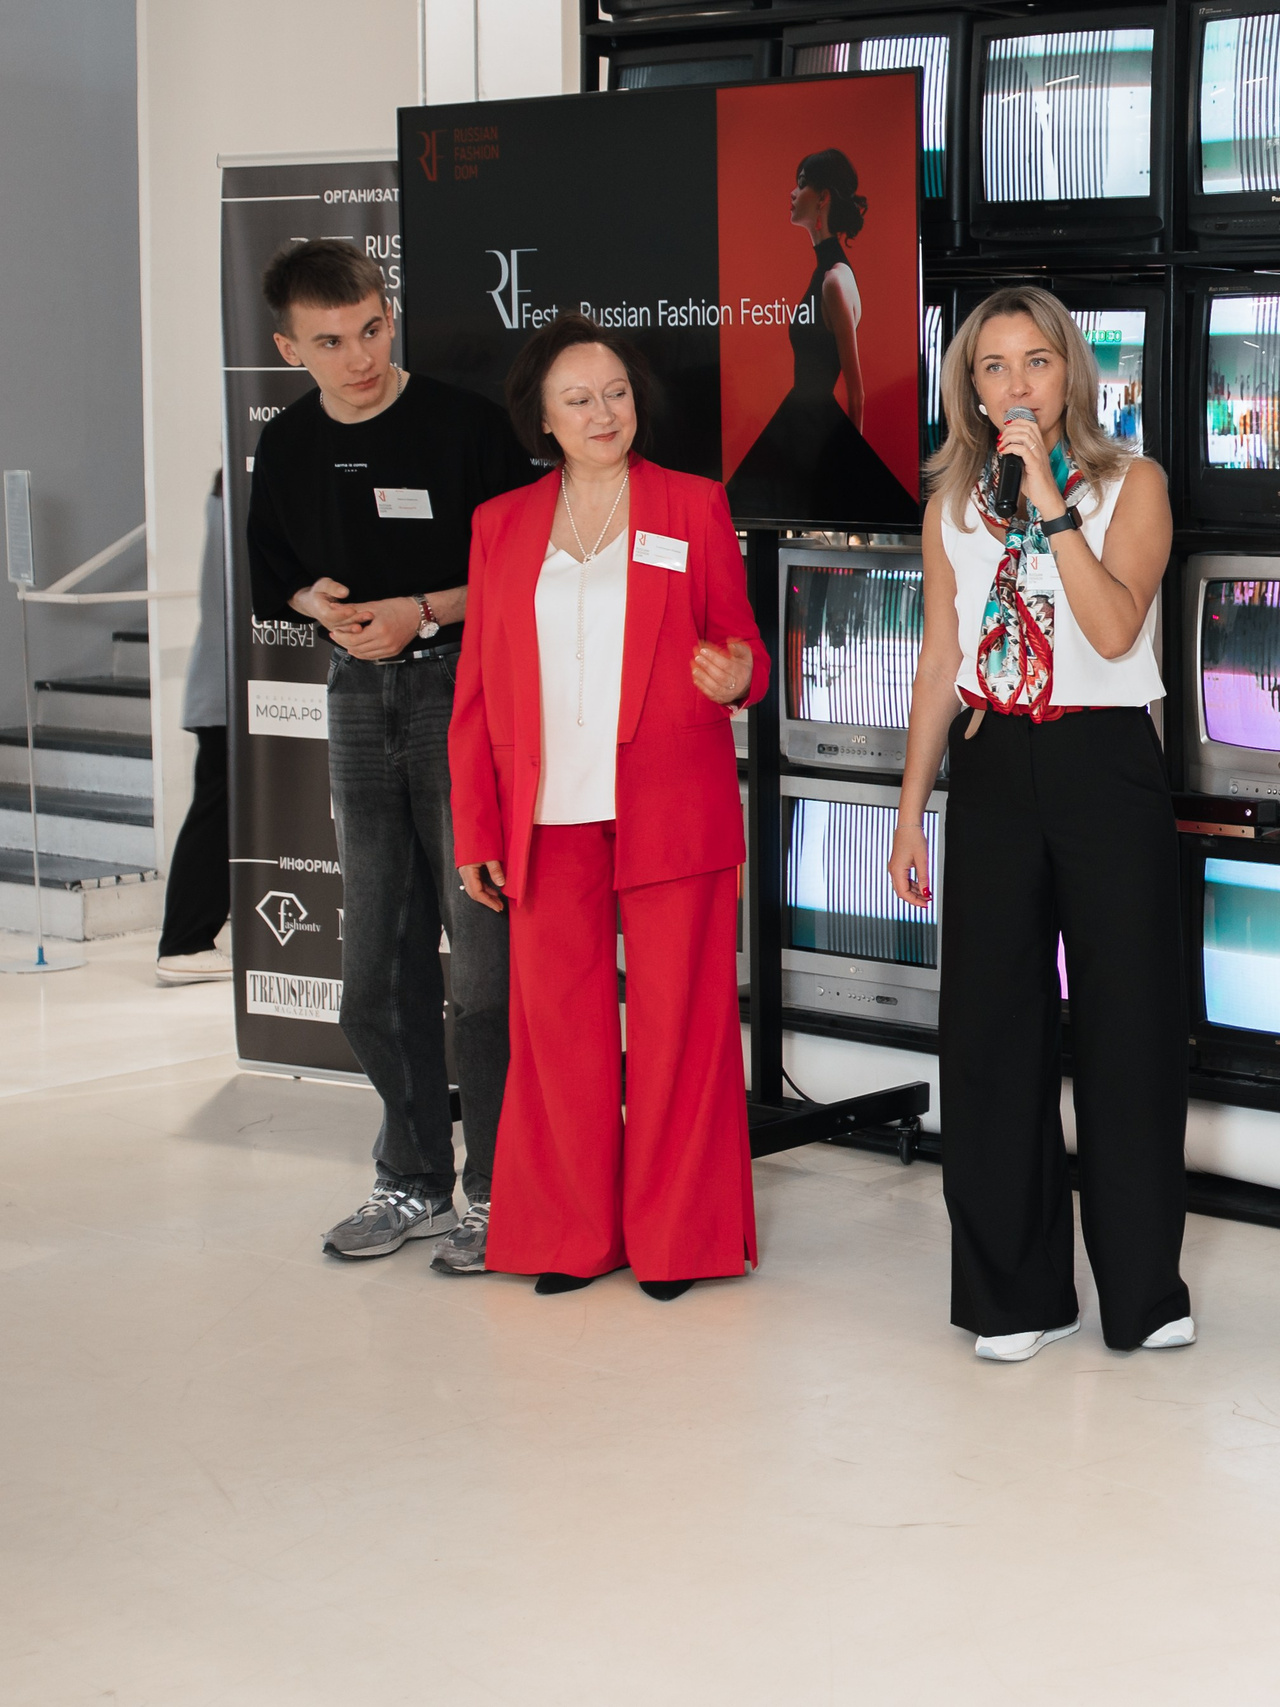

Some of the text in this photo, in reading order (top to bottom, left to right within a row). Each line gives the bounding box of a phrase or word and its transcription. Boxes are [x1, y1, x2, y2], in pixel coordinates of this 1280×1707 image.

[454, 126, 498, 142] RUSSIAN
[454, 145, 499, 161] FASHION
[455, 164, 478, 180] DOM
[580, 300, 651, 327] Russian
[658, 298, 732, 327] Fashion
[740, 295, 815, 325] Festival
[1083, 330, 1122, 342] VIDEO
[256, 704, 322, 722] МОДА.РФ
[851, 735, 866, 744] JVC
[274, 1005, 320, 1018] MAGAZINE
